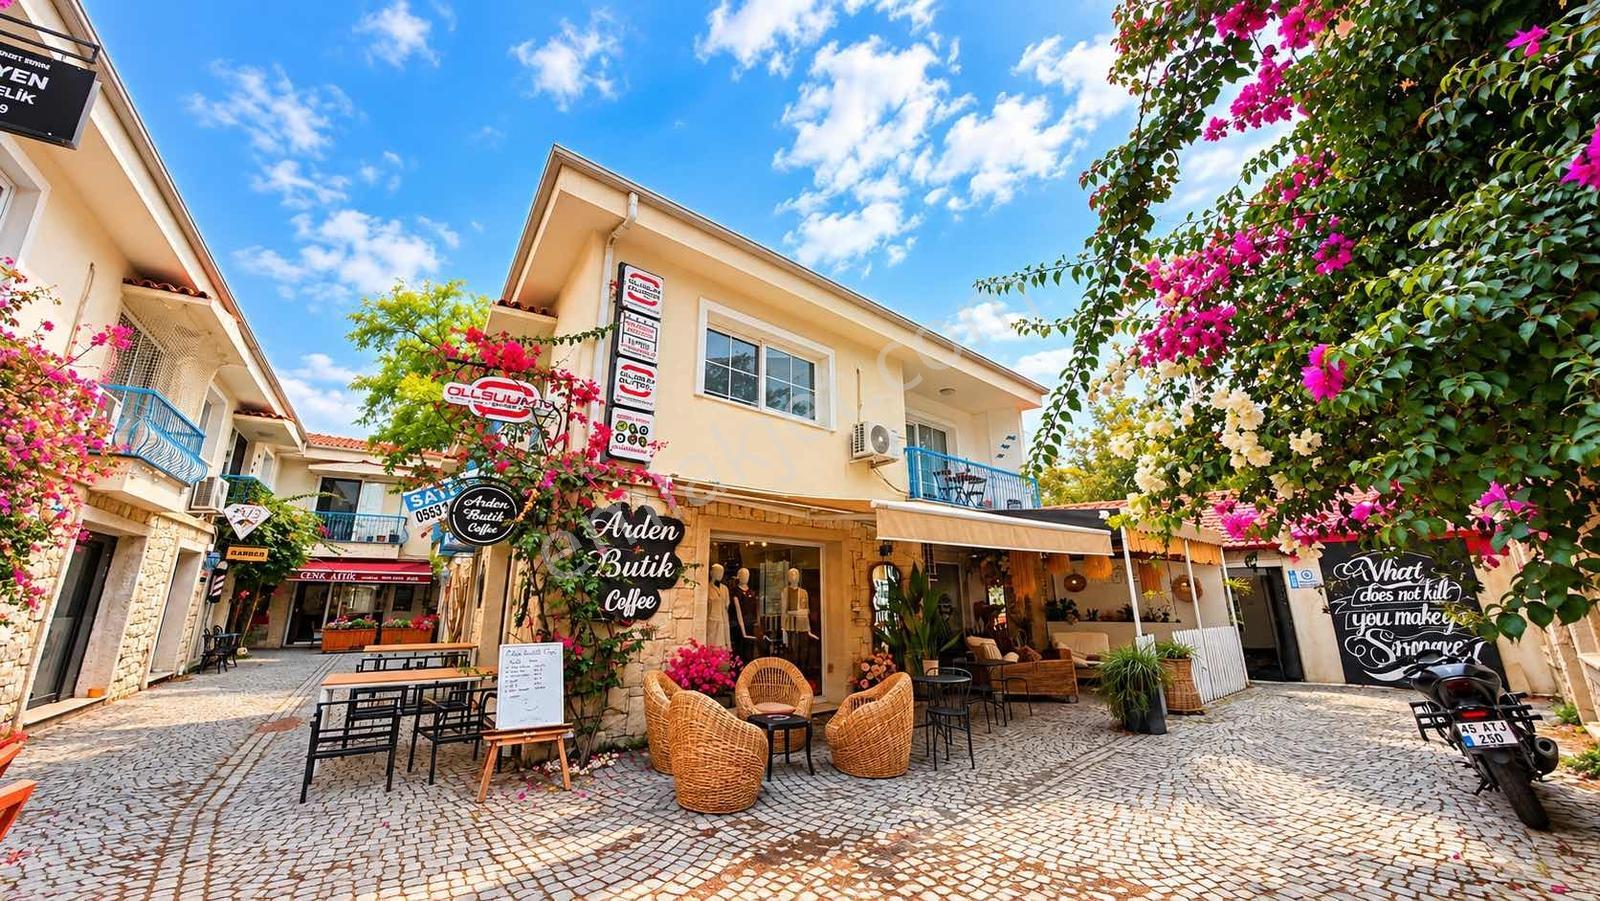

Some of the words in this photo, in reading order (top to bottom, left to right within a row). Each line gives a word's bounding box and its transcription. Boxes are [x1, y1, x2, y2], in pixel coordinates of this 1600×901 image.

[463, 495, 511, 509] Arden
[463, 508, 504, 523] Butik
[591, 511, 680, 541] Arden
[467, 522, 498, 536] Coffee
[588, 548, 676, 578] Butik
[1333, 556, 1425, 583] What
[1359, 584, 1393, 602] does
[1398, 588, 1422, 601] not
[1423, 578, 1452, 601] kill
[604, 588, 657, 618] Coffee
[1352, 612, 1392, 637] you
[1461, 723, 1477, 734] 45
[1483, 722, 1507, 732] ATJ
[1479, 733, 1504, 744] 250
